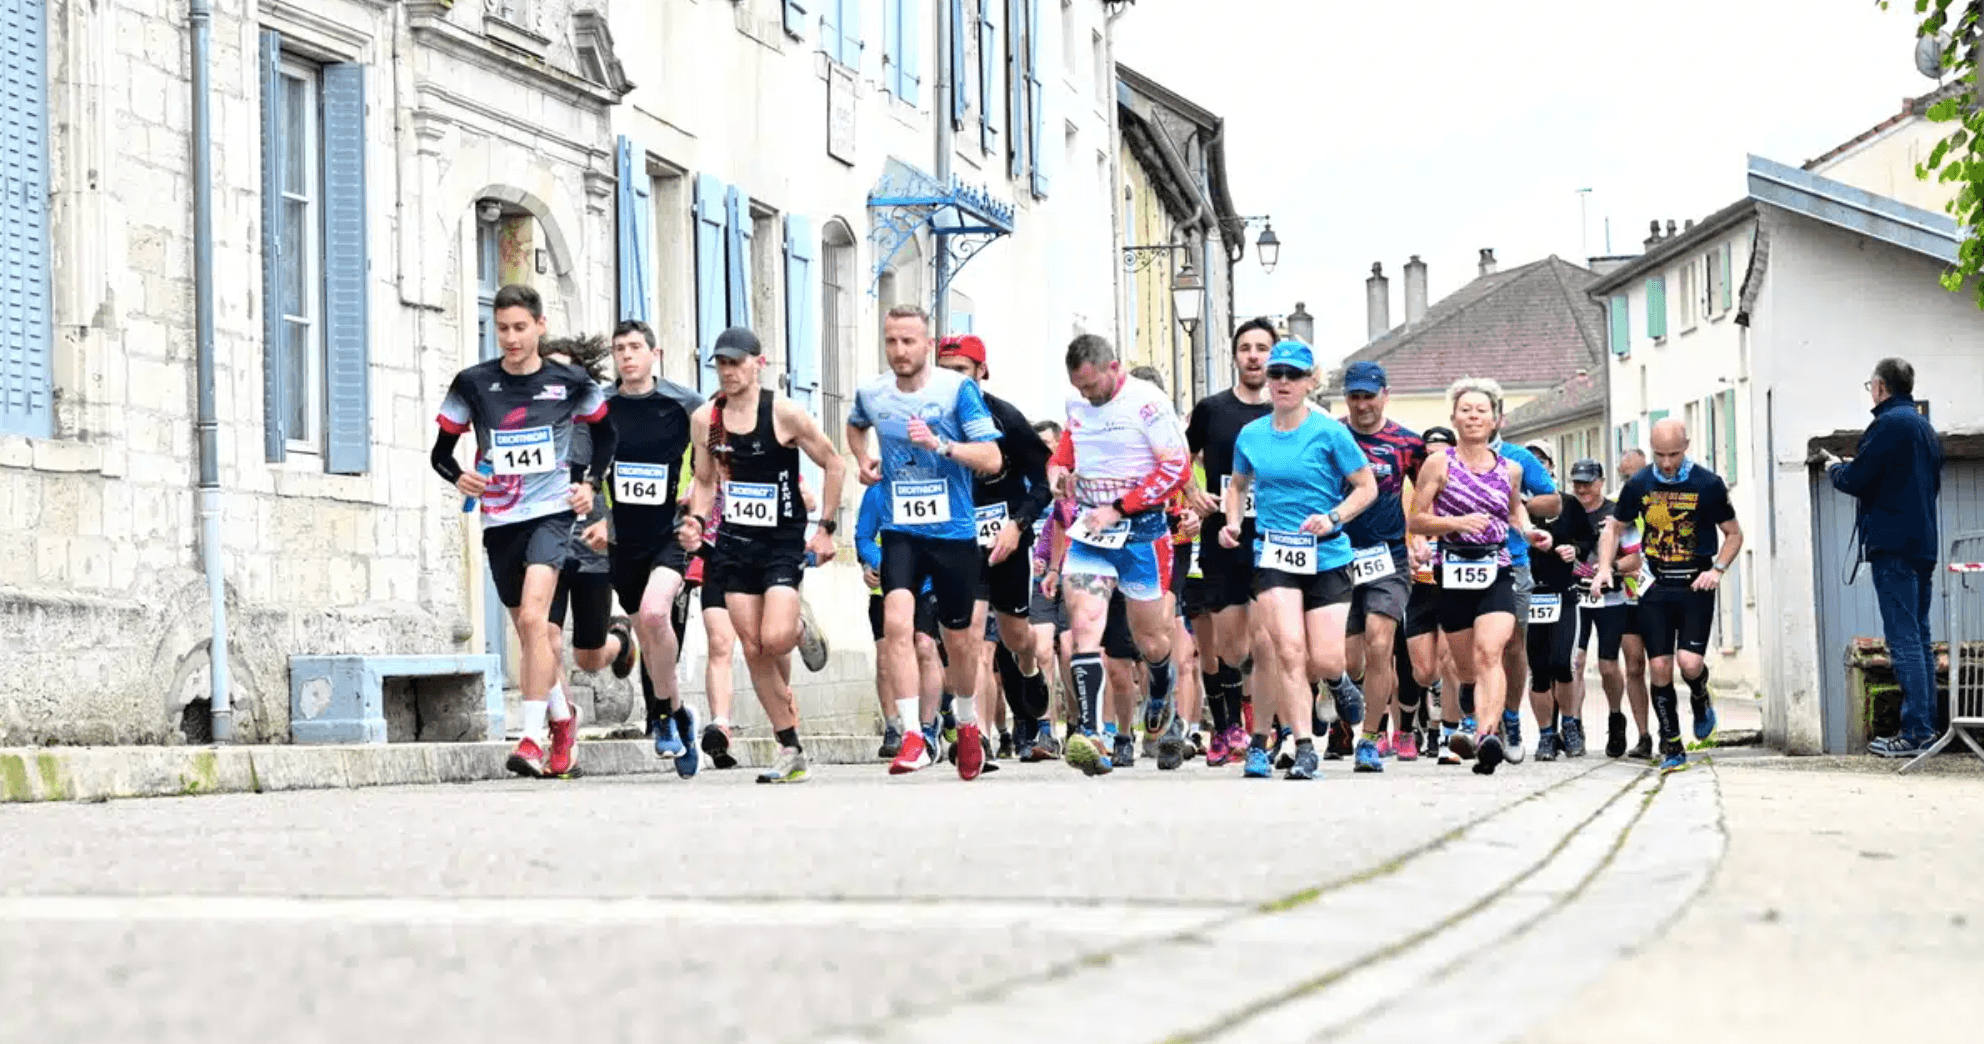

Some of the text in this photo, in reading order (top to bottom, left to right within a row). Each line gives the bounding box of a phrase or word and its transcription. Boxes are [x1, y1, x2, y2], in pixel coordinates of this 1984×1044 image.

[505, 448, 542, 468] 141
[622, 481, 657, 498] 164
[733, 501, 767, 519] 140
[903, 499, 937, 517] 161
[1274, 548, 1306, 567] 148
[1352, 558, 1385, 578] 156
[1453, 567, 1489, 584] 155
[1528, 607, 1555, 619] 157
